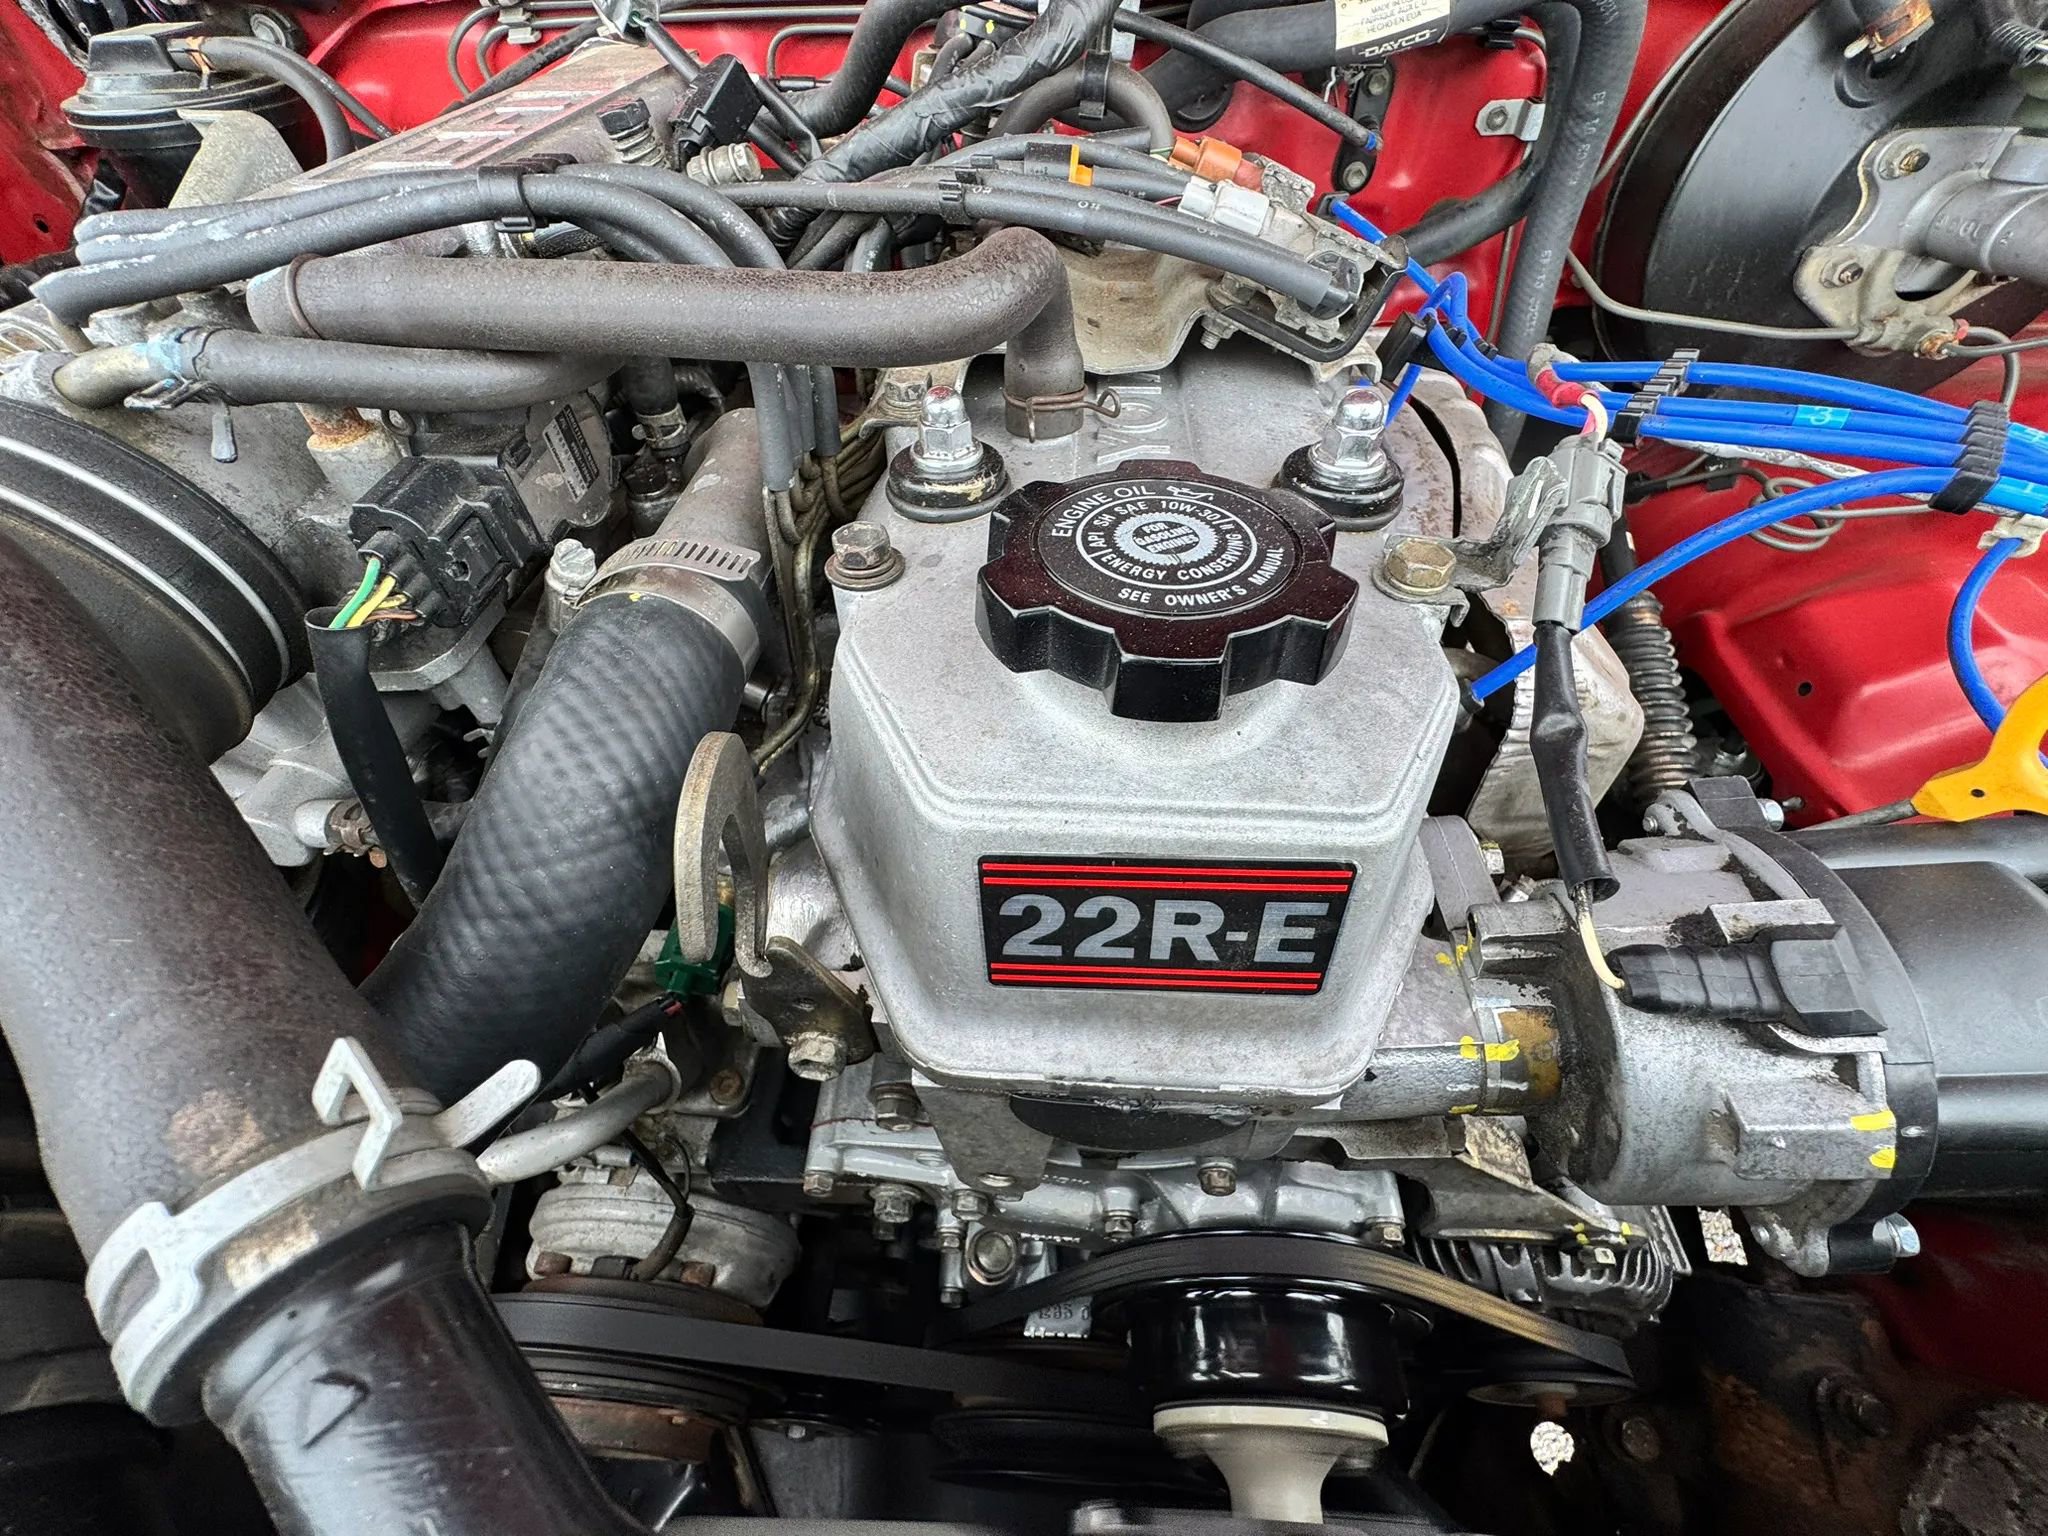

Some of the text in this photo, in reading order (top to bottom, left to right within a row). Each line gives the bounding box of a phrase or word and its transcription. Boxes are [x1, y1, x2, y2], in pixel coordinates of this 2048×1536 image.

[1363, 28, 1432, 58] DAYCO
[1809, 406, 1833, 425] 3
[1051, 485, 1156, 537] ENGINE OIL
[1087, 500, 1221, 548] API SH SAE 10W-30
[1141, 522, 1170, 534] FOR
[1134, 525, 1194, 546] GASOLINE
[1146, 534, 1200, 553] ENGINES
[1101, 553, 1168, 580] ENERGY
[1177, 533, 1245, 581] CONSERVING
[1118, 546, 1285, 606] SEE OWNER'S MANUAL
[999, 893, 1328, 963] 22R-E
